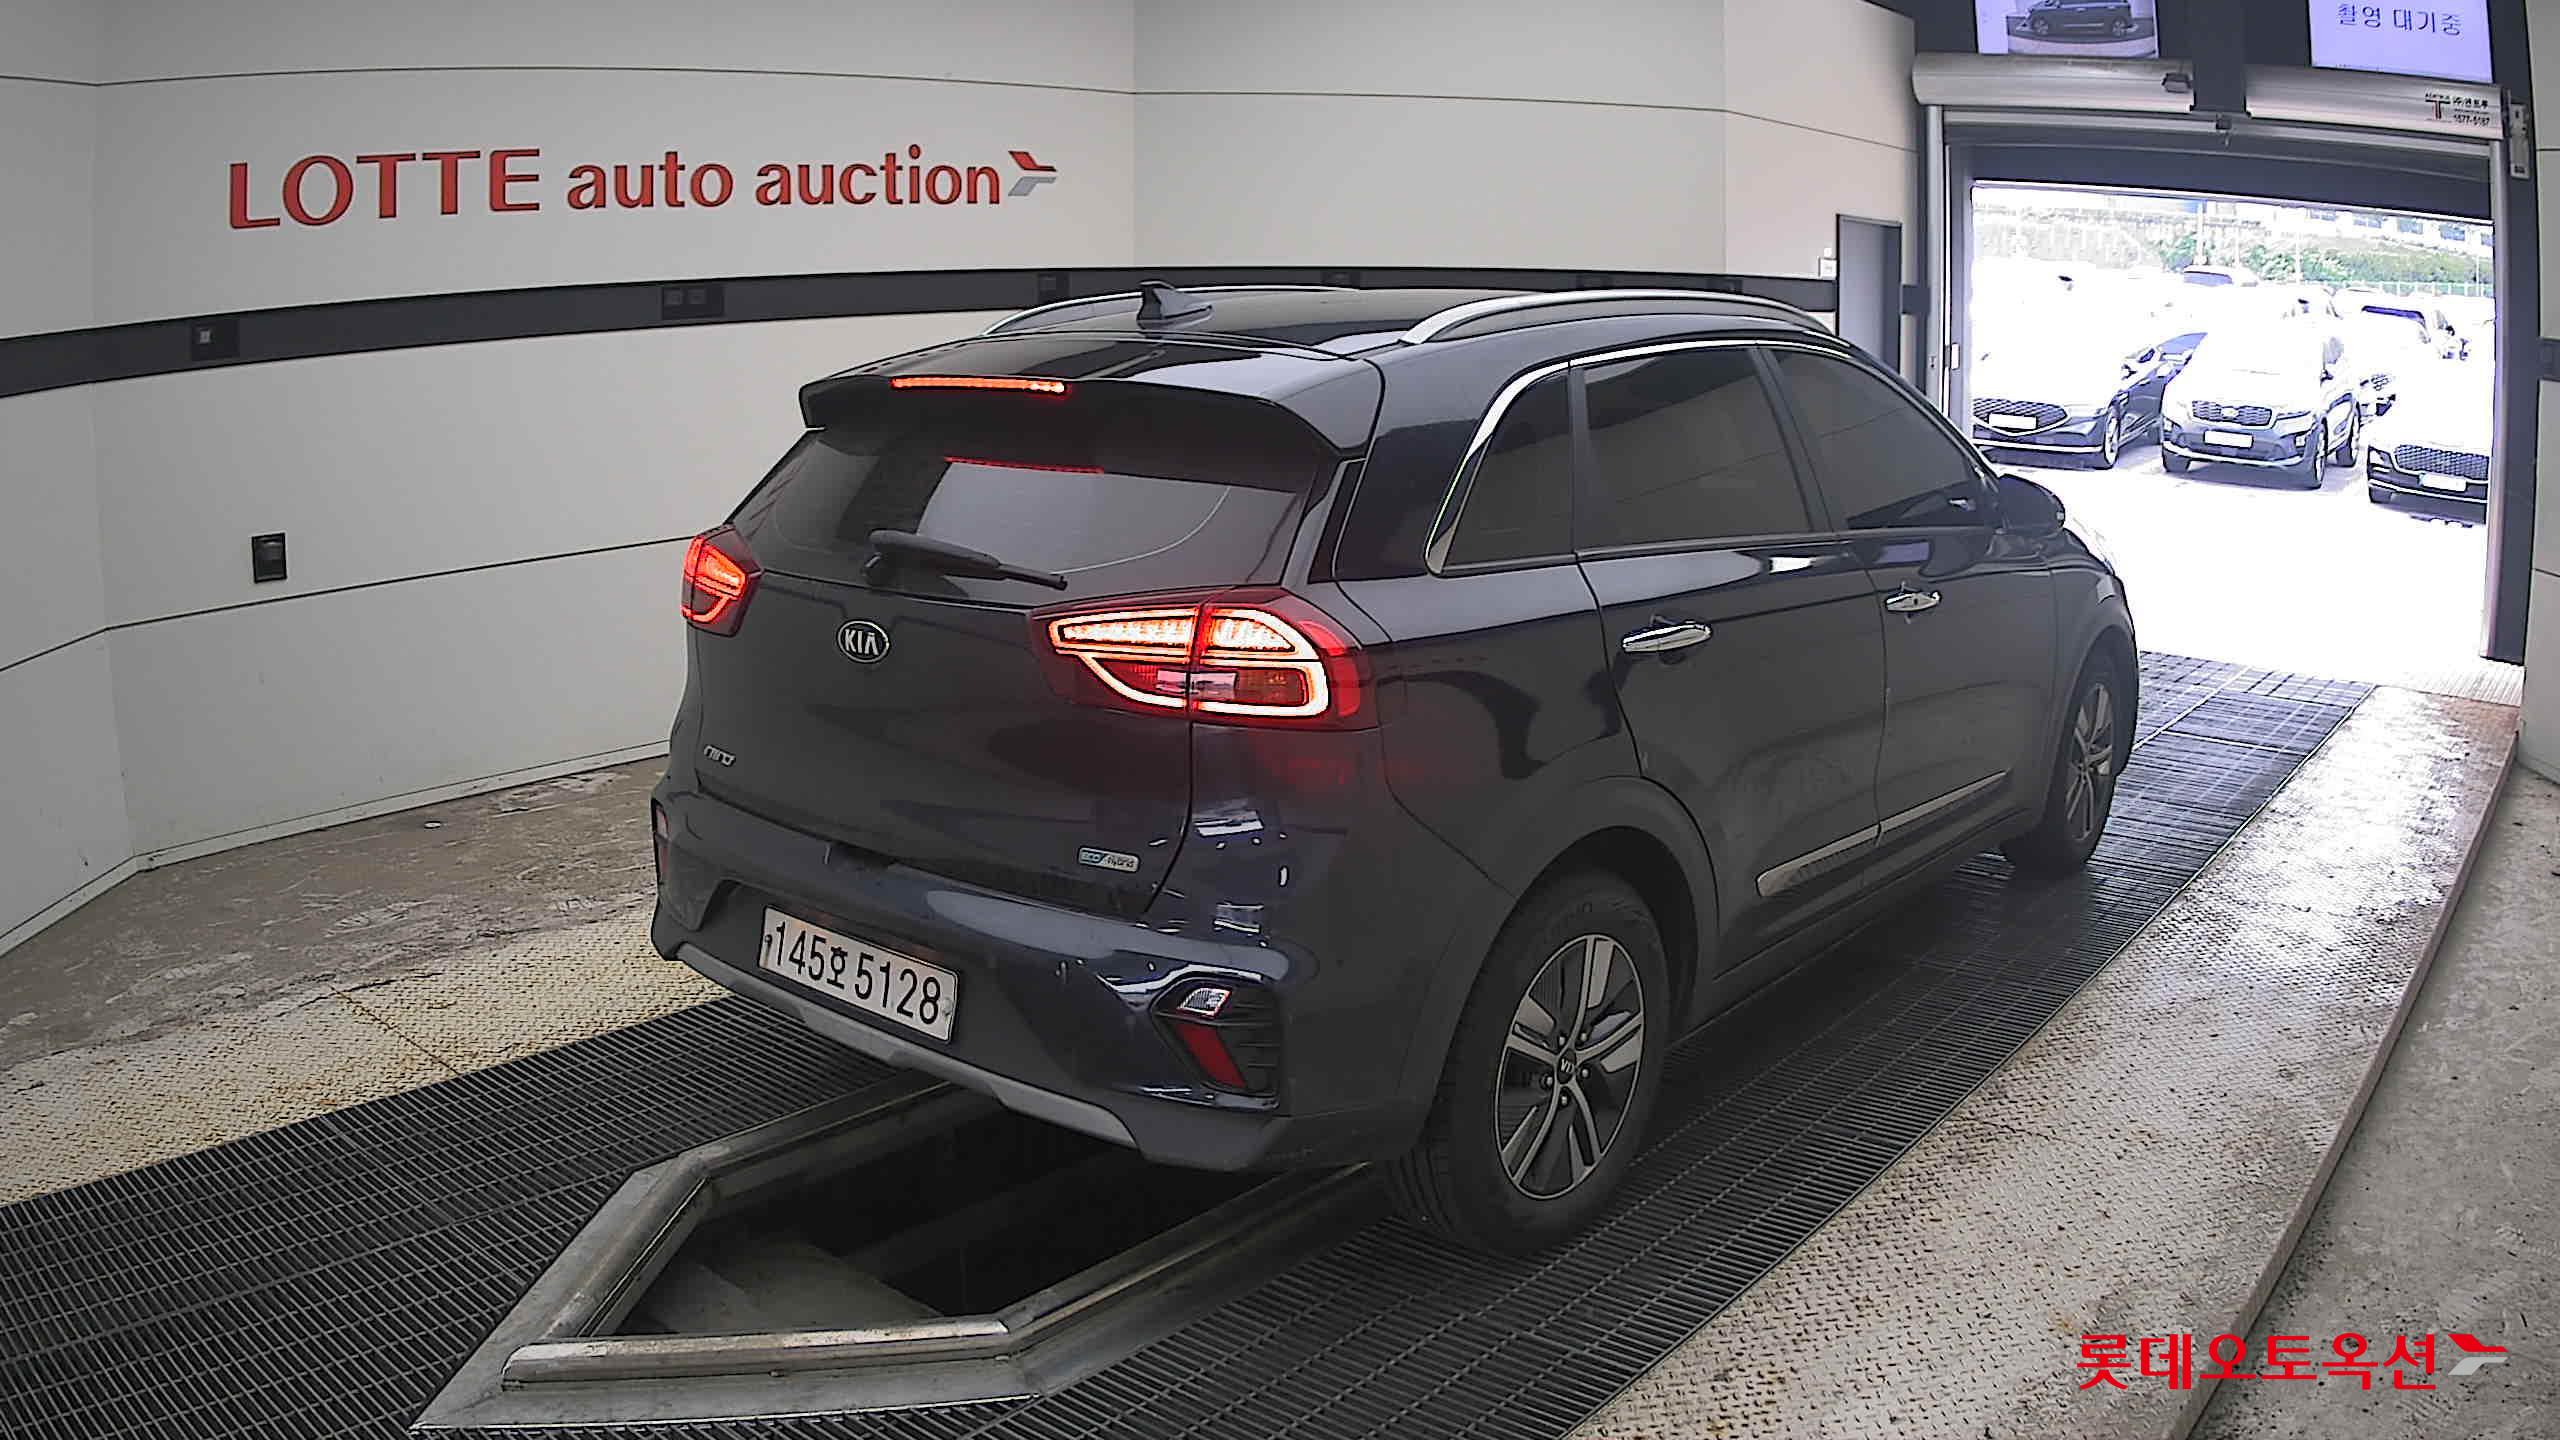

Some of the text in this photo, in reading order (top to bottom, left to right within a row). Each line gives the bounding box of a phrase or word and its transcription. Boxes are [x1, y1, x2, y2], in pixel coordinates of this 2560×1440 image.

[2338, 3, 2461, 36] 촬영 대기중
[229, 145, 1002, 229] LOTTE auto auction
[845, 629, 879, 656] KIA
[775, 921, 941, 1025] 145호 5128
